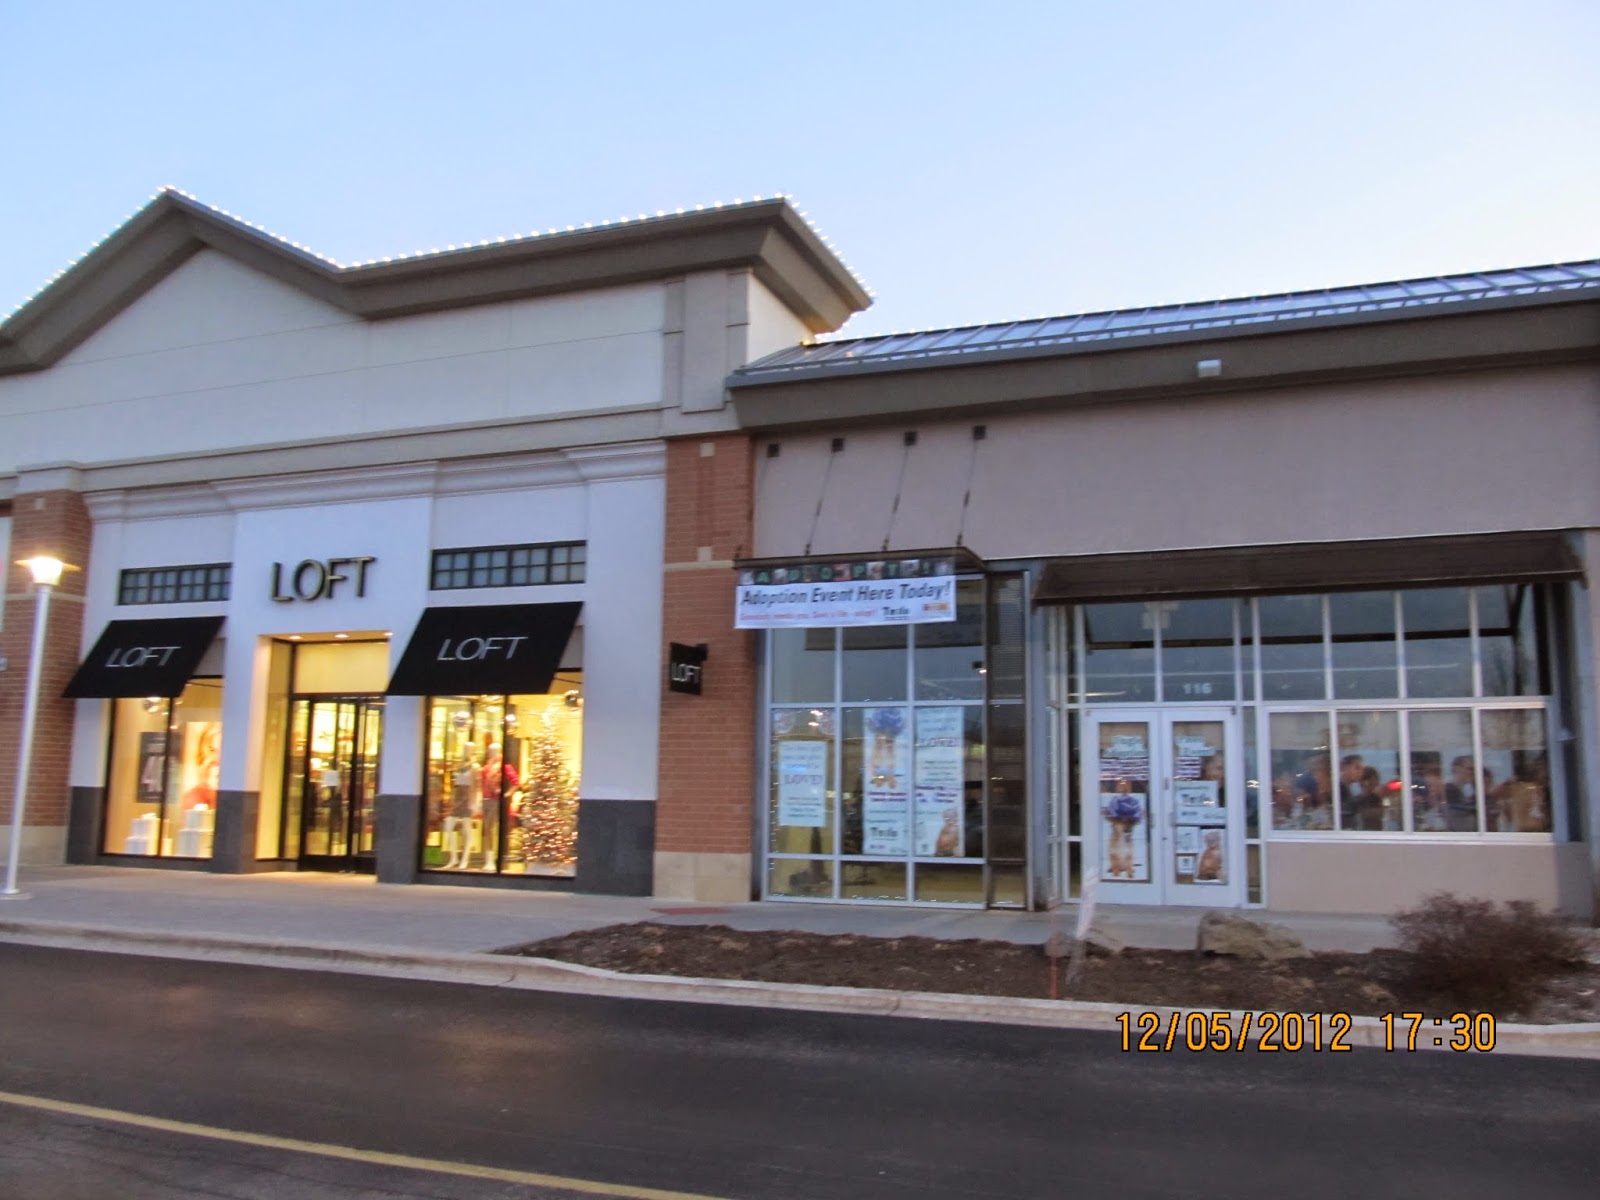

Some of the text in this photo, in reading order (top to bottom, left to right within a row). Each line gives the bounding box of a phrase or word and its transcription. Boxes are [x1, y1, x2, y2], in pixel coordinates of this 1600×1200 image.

[271, 556, 377, 603] LOFT
[740, 580, 951, 607] Adoption Event Here Today!
[105, 645, 181, 669] LOFT
[437, 635, 529, 662] LOFT
[671, 662, 702, 684] LOFT
[1182, 682, 1213, 695] 116
